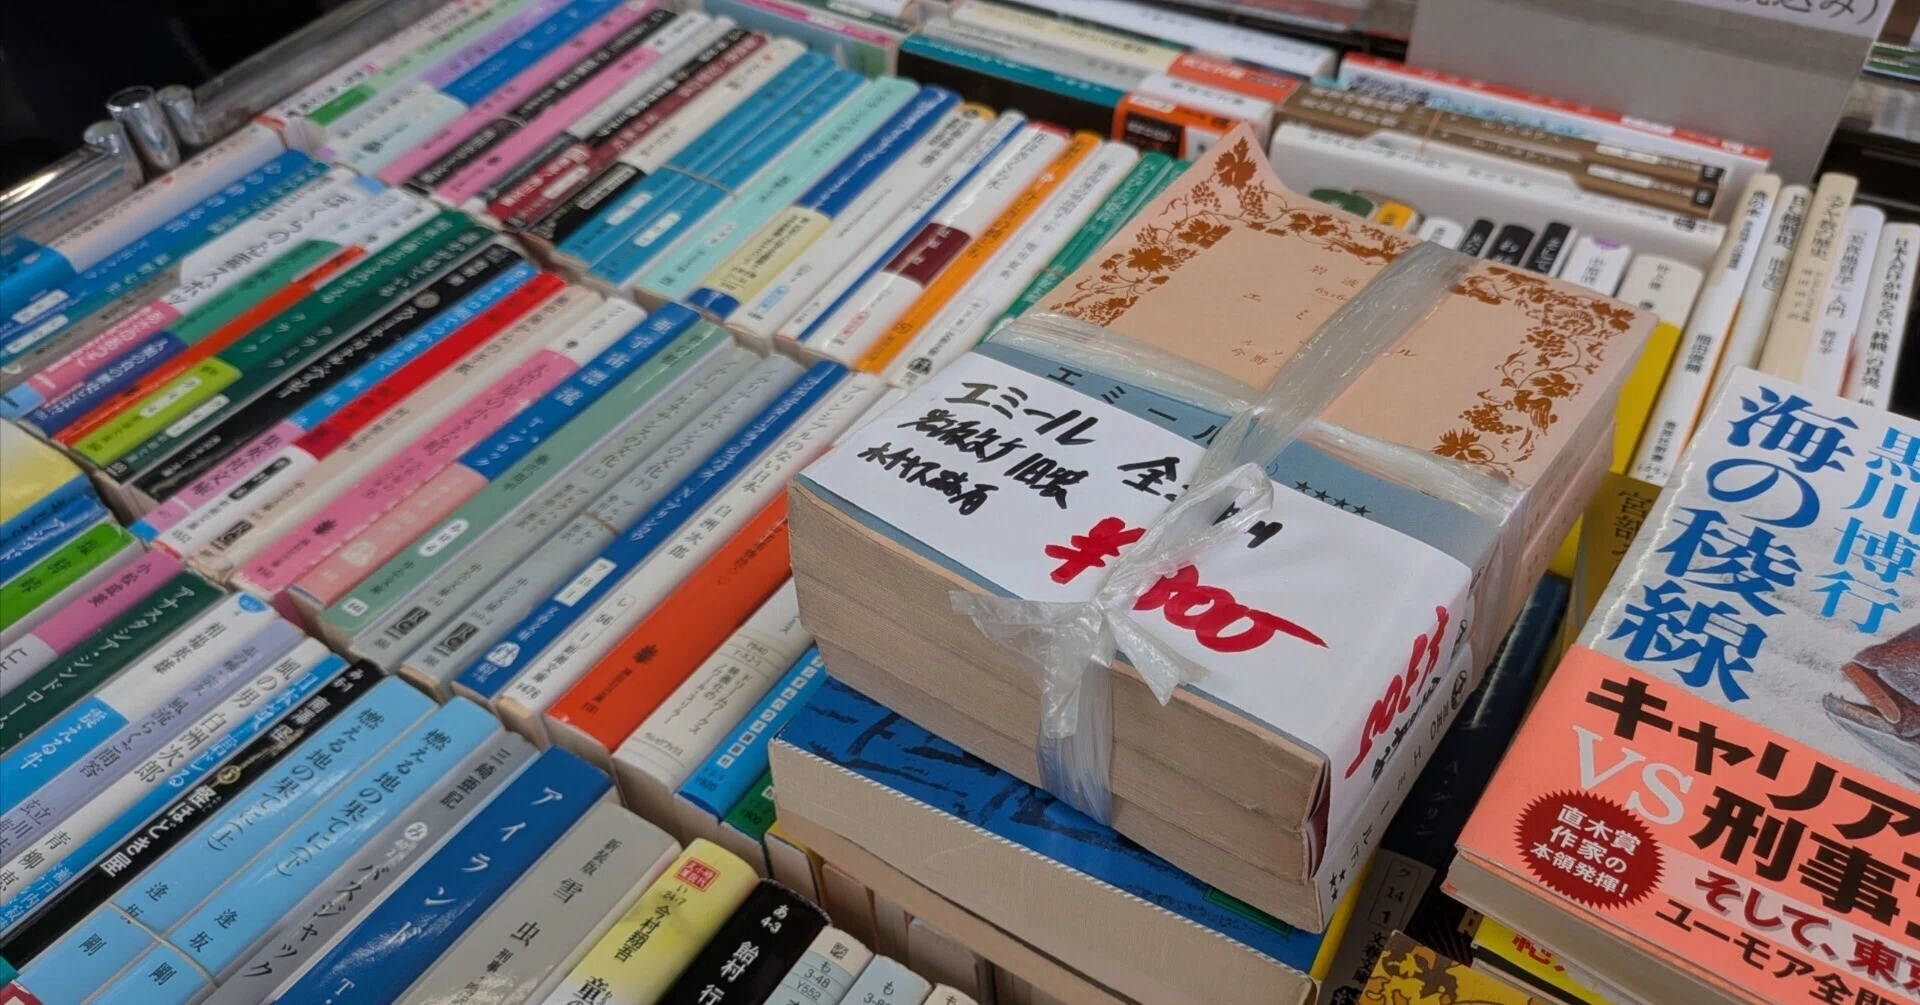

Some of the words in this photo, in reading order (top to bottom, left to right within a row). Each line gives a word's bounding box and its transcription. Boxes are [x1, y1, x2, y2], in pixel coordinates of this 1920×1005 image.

[554, 317, 675, 407] 亜宇宙漂流
[740, 384, 868, 494] プリンシプルのない日本
[944, 381, 1099, 446] エミール
[193, 433, 282, 497] 集英社文庫
[667, 504, 732, 560] 白洲次郎
[1607, 385, 1861, 704] 海の稜線
[1814, 426, 1920, 635] 黒川博行
[153, 622, 227, 676] 相場英雄
[230, 657, 302, 710] 風の男
[689, 672, 753, 736] ドリームワークス
[21, 708, 108, 771] 震える牛
[79, 696, 190, 778] 風流らくご問答
[134, 711, 227, 784] 白洲次郎
[1585, 676, 1920, 841] キャリア
[206, 707, 386, 852] 燃える地の果てに(上)
[274, 729, 454, 877] 燃える地の果てに(下)
[439, 748, 511, 810] 三崎亜記
[1573, 725, 1695, 826] VS
[580, 838, 623, 876] 新装版
[1549, 825, 1630, 875] 作家の
[1557, 803, 1643, 857] 直木賞
[390, 786, 564, 945] アイランド
[1530, 842, 1631, 899] 本領発揮!
[244, 862, 391, 978] バスジャック
[510, 877, 584, 947] 雪虫
[613, 903, 672, 964] 今村翔吾
[772, 904, 791, 920] あ
[147, 908, 239, 987] 逢坂剛
[720, 940, 760, 983] 飴村
[803, 968, 831, 988] 3-48
[820, 960, 832, 973] も
[882, 980, 896, 996] も
